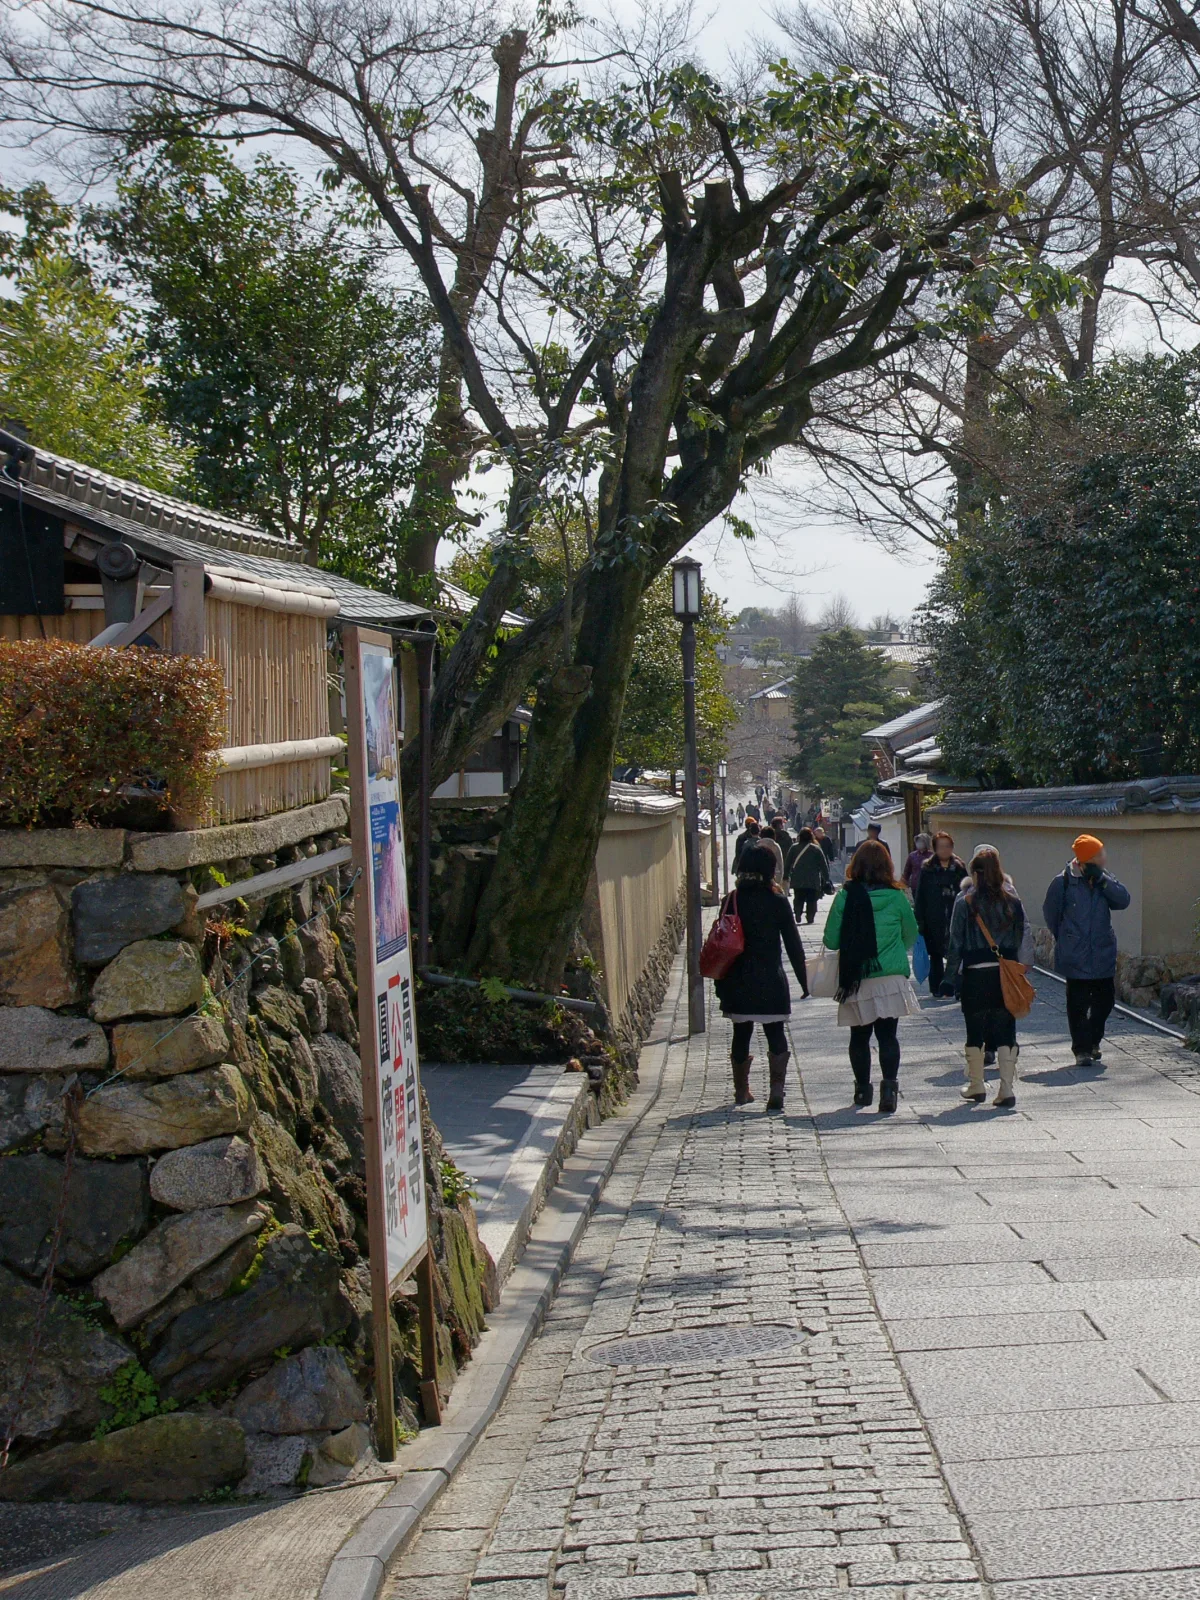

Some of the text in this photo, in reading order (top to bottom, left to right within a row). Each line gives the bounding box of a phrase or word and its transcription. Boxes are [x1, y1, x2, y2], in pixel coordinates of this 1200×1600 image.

[391, 1001, 409, 1238] 公開中
[401, 977, 421, 1205] 高台寺
